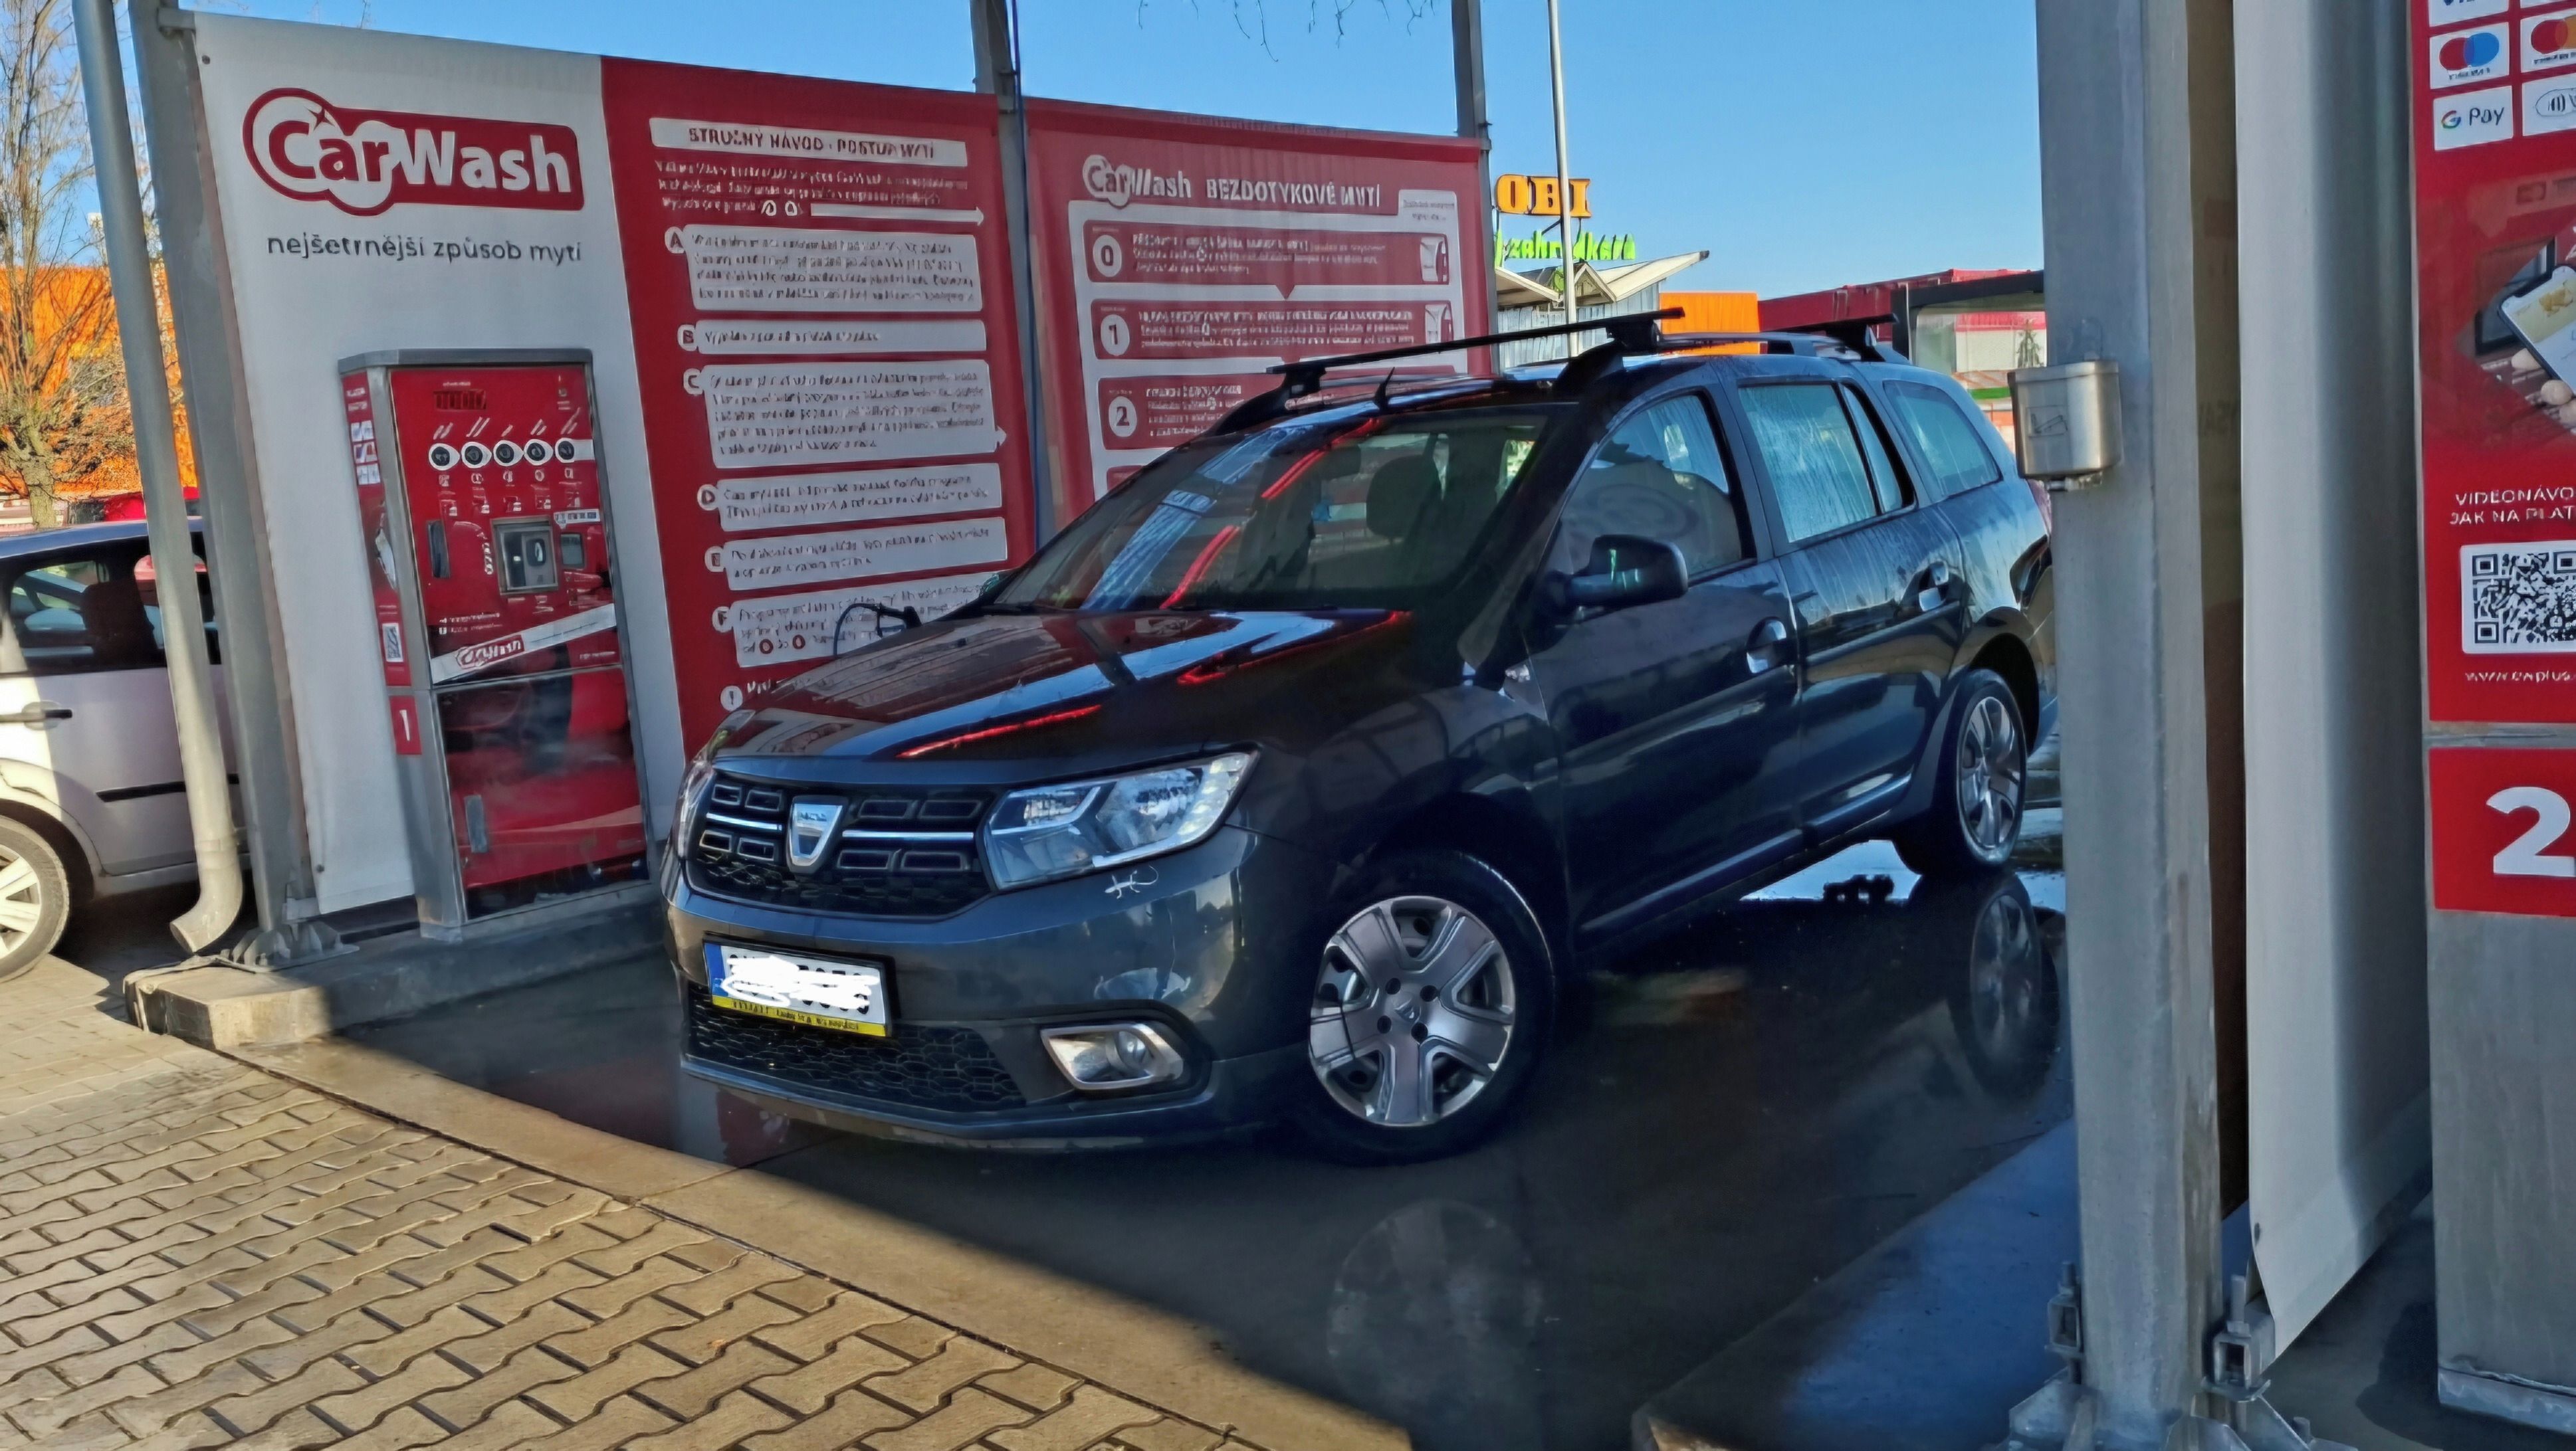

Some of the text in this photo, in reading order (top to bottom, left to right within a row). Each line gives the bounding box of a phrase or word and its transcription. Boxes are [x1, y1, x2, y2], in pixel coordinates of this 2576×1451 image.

[268, 119, 572, 193] CarWash
[1495, 173, 1591, 218] OBI
[1115, 405, 1130, 427] 2
[399, 709, 411, 741] 1
[2486, 786, 2575, 878] 2
